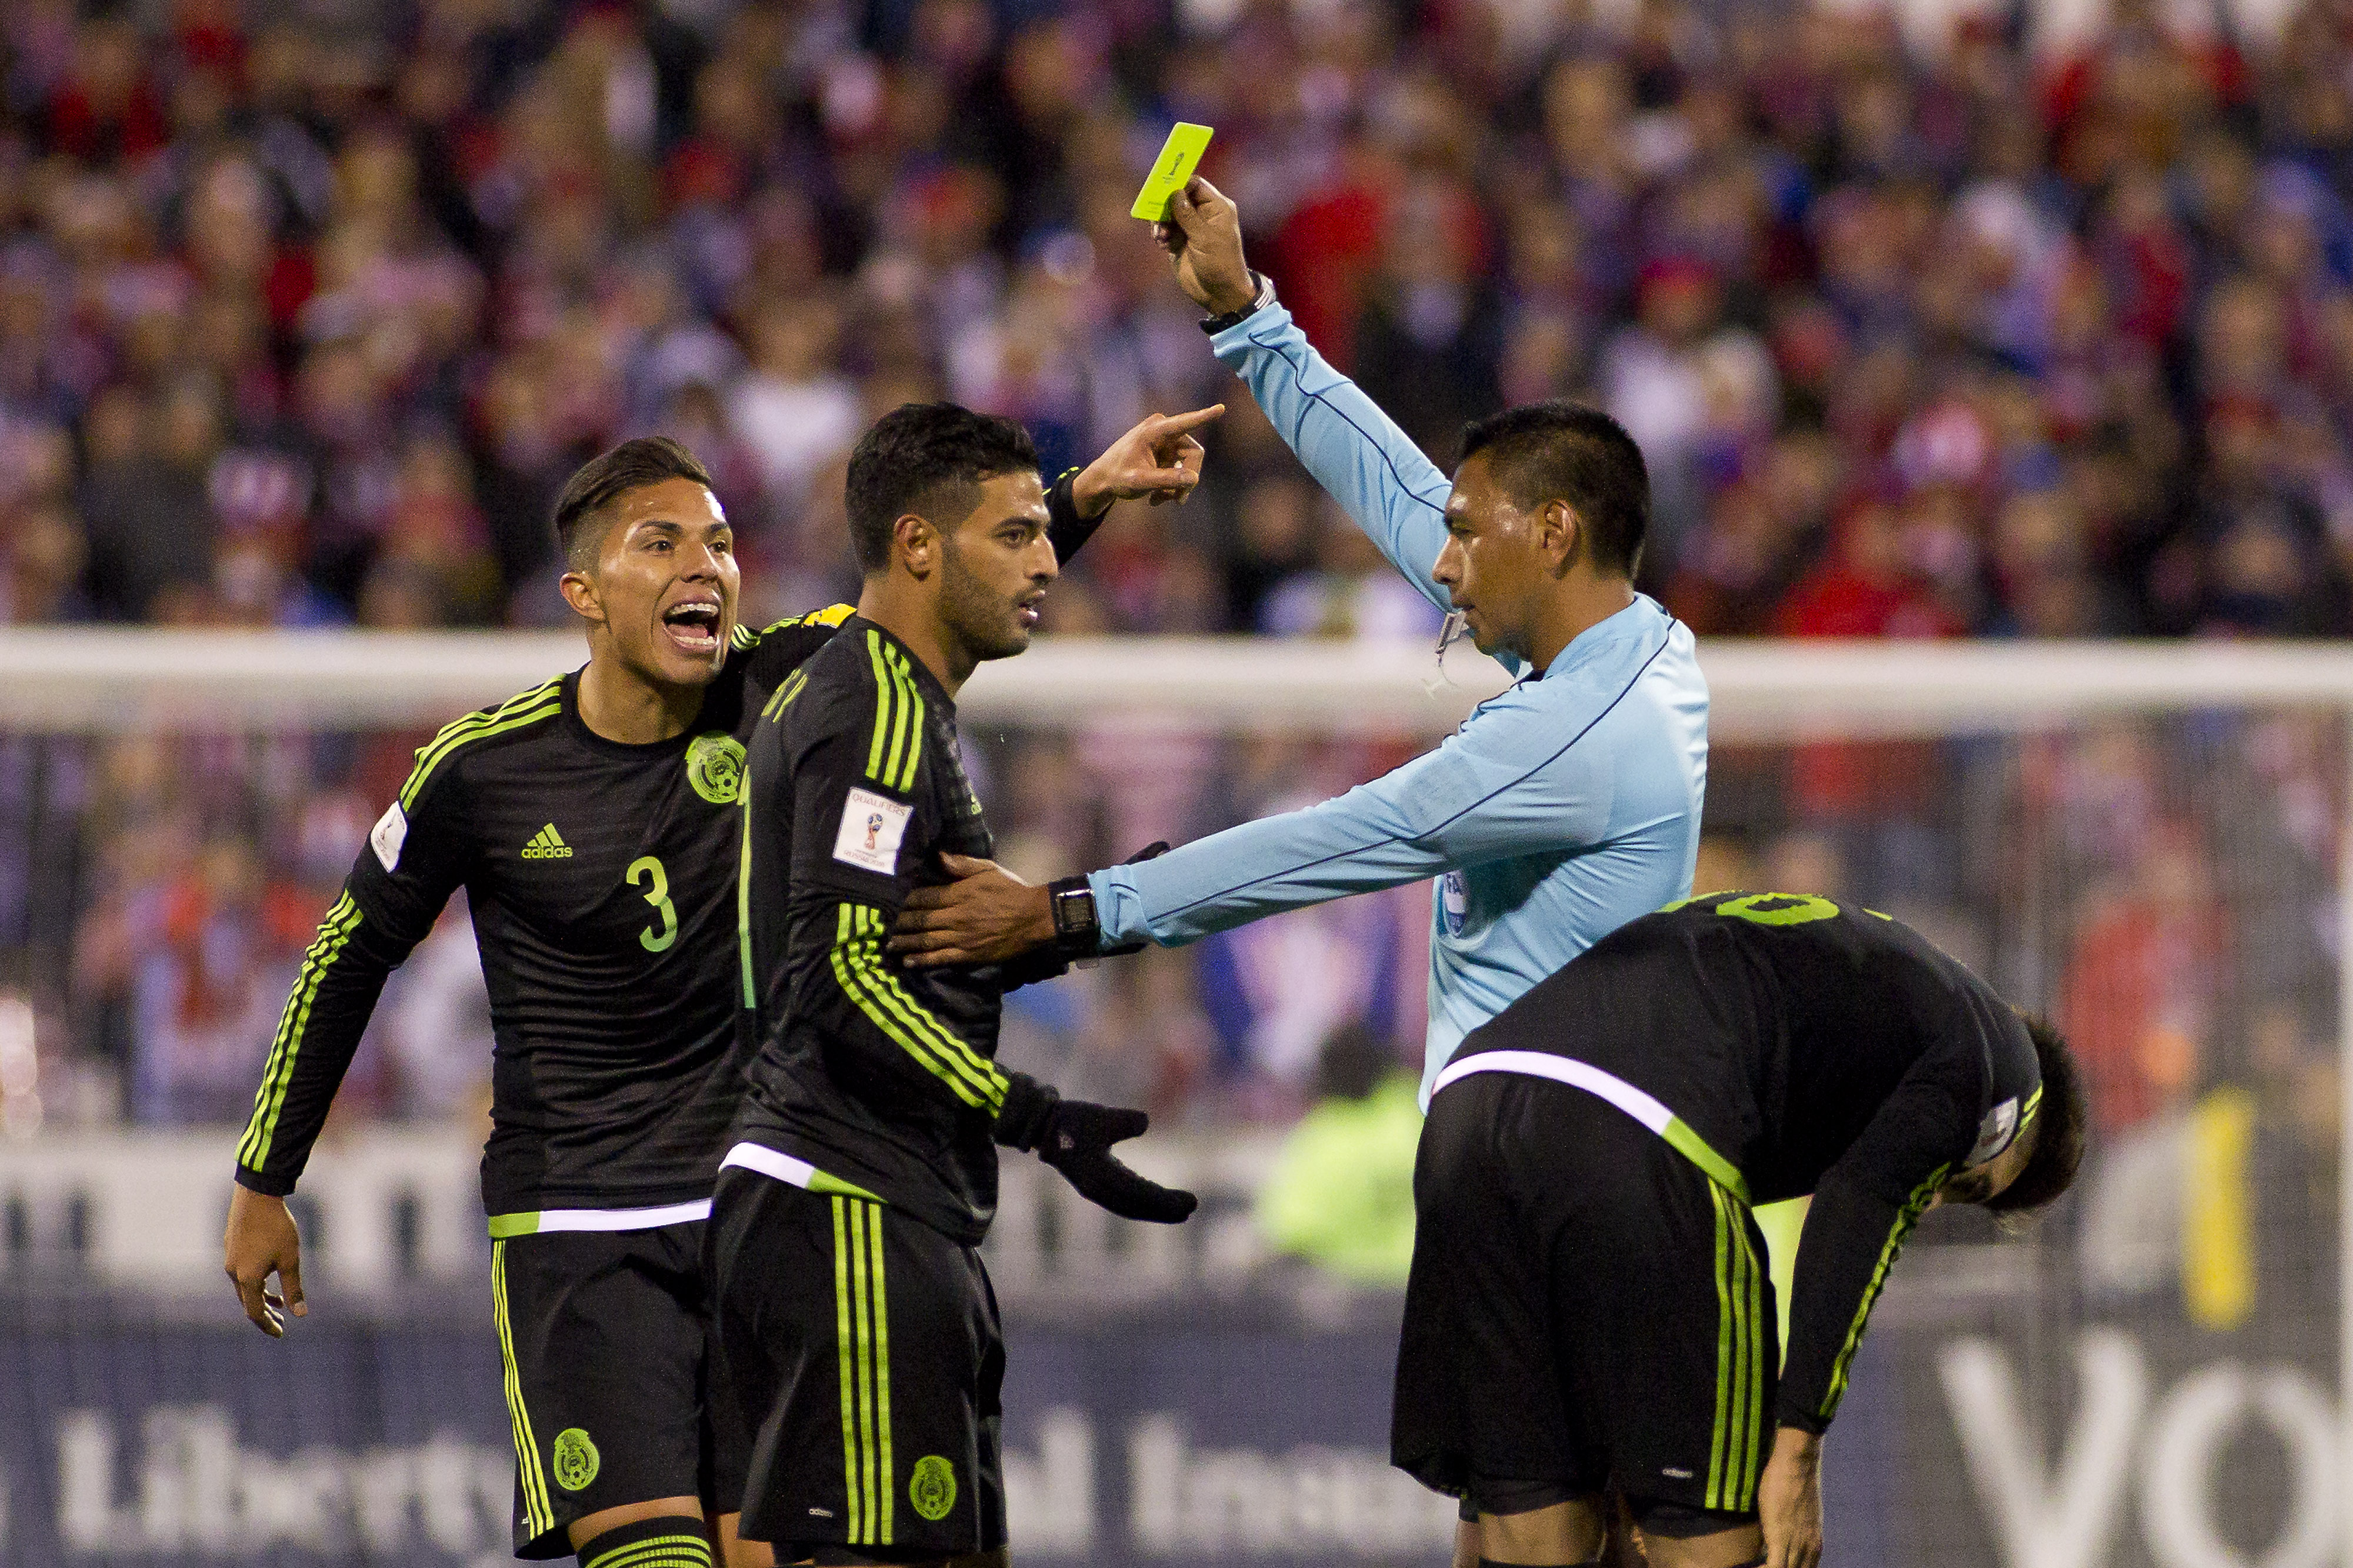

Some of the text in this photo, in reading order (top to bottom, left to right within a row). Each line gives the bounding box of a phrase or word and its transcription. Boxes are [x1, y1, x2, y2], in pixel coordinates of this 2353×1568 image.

[852, 793, 905, 816] QUALIFIERS
[521, 845, 573, 859] adidas
[626, 856, 678, 952] 3
